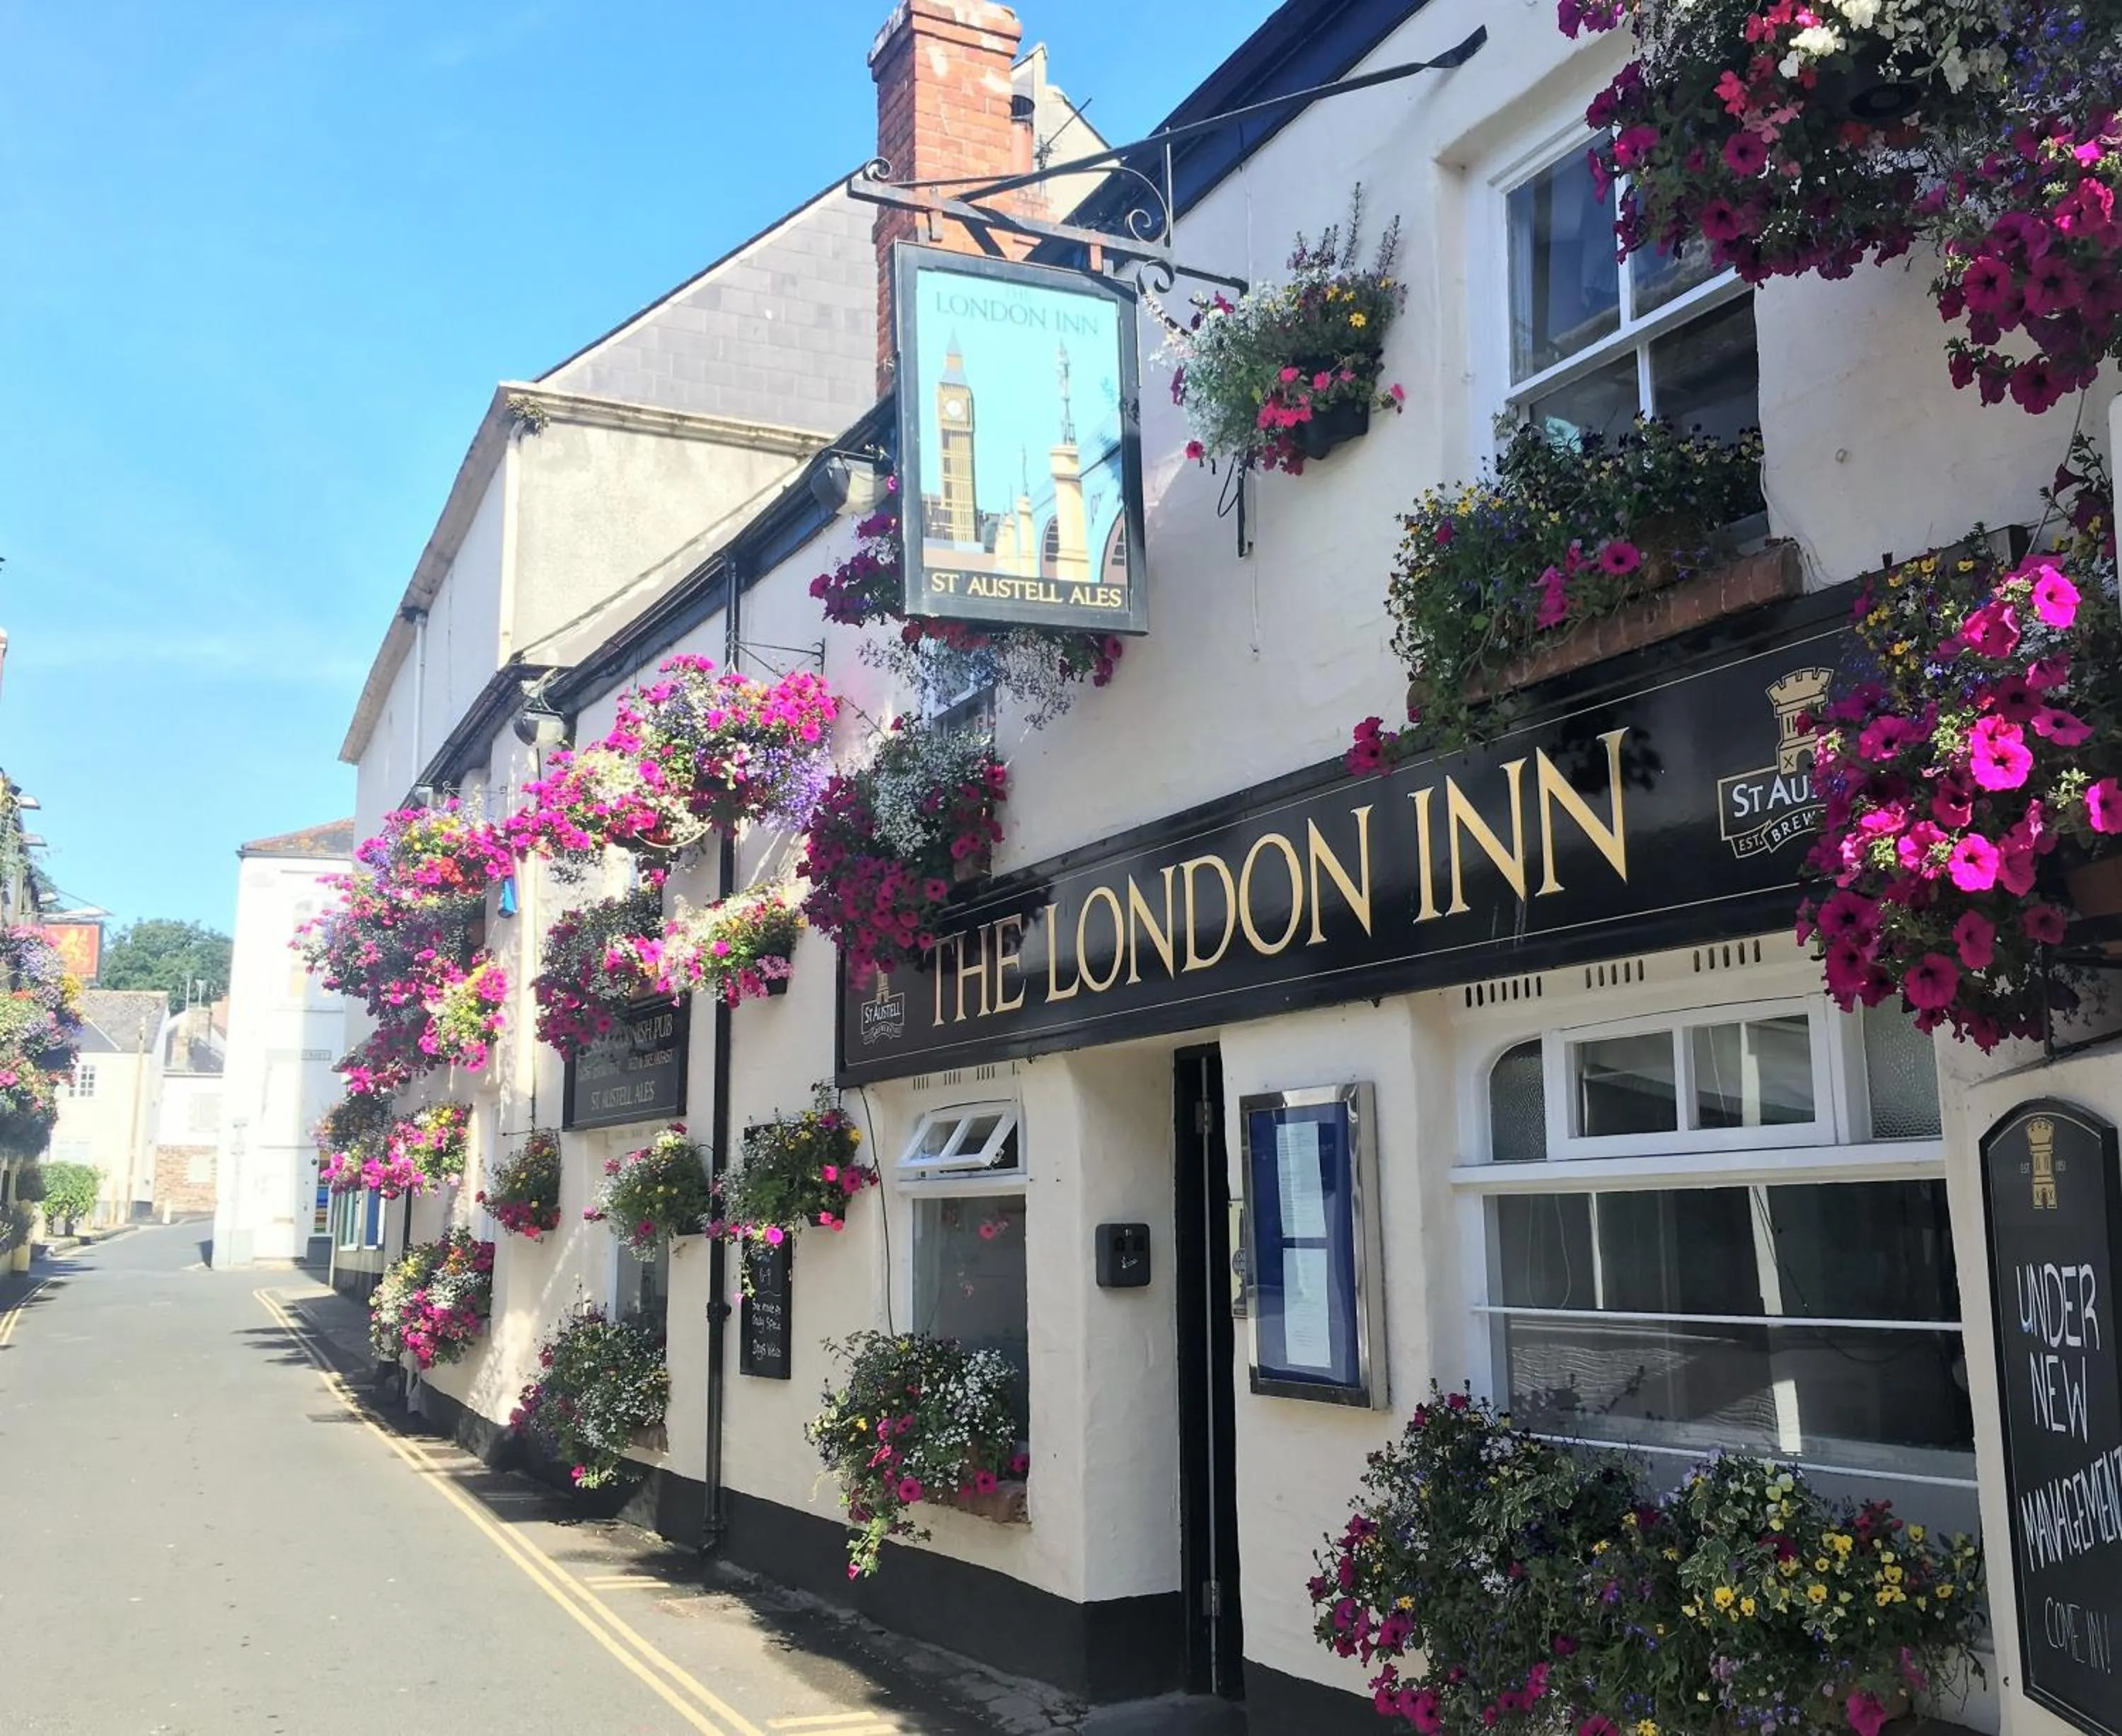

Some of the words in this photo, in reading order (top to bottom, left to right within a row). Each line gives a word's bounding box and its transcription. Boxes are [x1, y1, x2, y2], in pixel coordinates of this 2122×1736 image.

[936, 291, 1048, 332] LONDON
[1055, 309, 1099, 337] INN
[932, 571, 960, 594] ST
[966, 574, 1064, 605] AUSTELL
[1069, 584, 1122, 608] ALES
[1771, 809, 1826, 843] BREW
[923, 913, 1027, 1028] THE
[1045, 804, 1374, 1003] LONDON
[1407, 726, 1630, 925] INN
[652, 1013, 673, 1040] PUB
[873, 1002, 900, 1022] AUSTELL
[601, 1084, 633, 1109] AUSTELL
[634, 1080, 656, 1103] ALES
[2016, 1262, 2100, 1351] UNDER
[2029, 1351, 2087, 1444] NEW
[2045, 1596, 2087, 1664] COME
[2087, 1609, 2111, 1674] IN!
